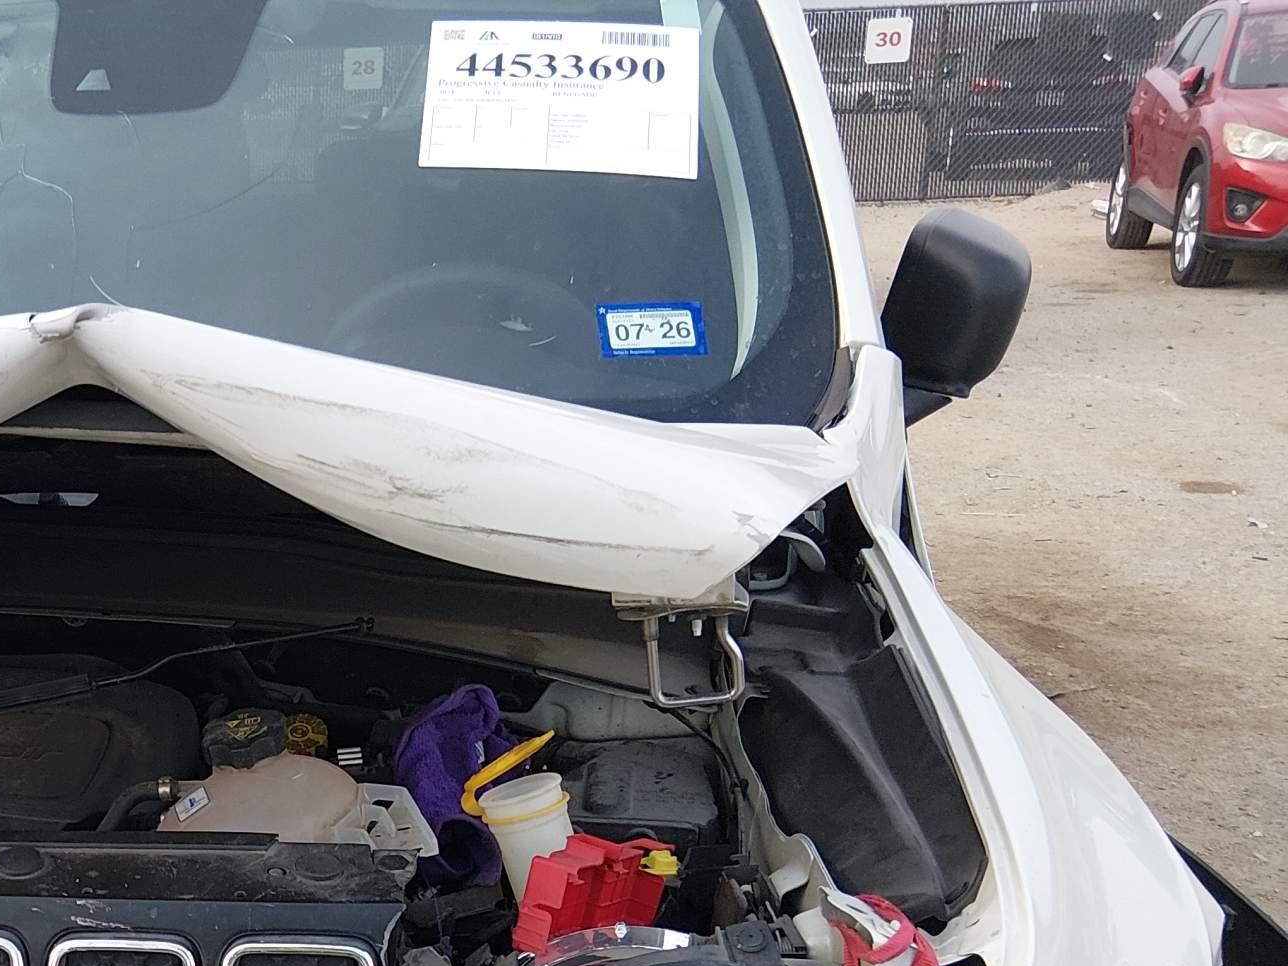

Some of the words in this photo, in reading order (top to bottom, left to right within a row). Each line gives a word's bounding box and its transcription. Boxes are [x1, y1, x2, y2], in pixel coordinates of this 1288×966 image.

[875, 32, 902, 48] 30
[352, 60, 376, 76] 28
[455, 53, 665, 83] 44533690
[438, 79, 500, 89] Progressive
[615, 323, 644, 341] 07
[660, 322, 691, 339] 26
